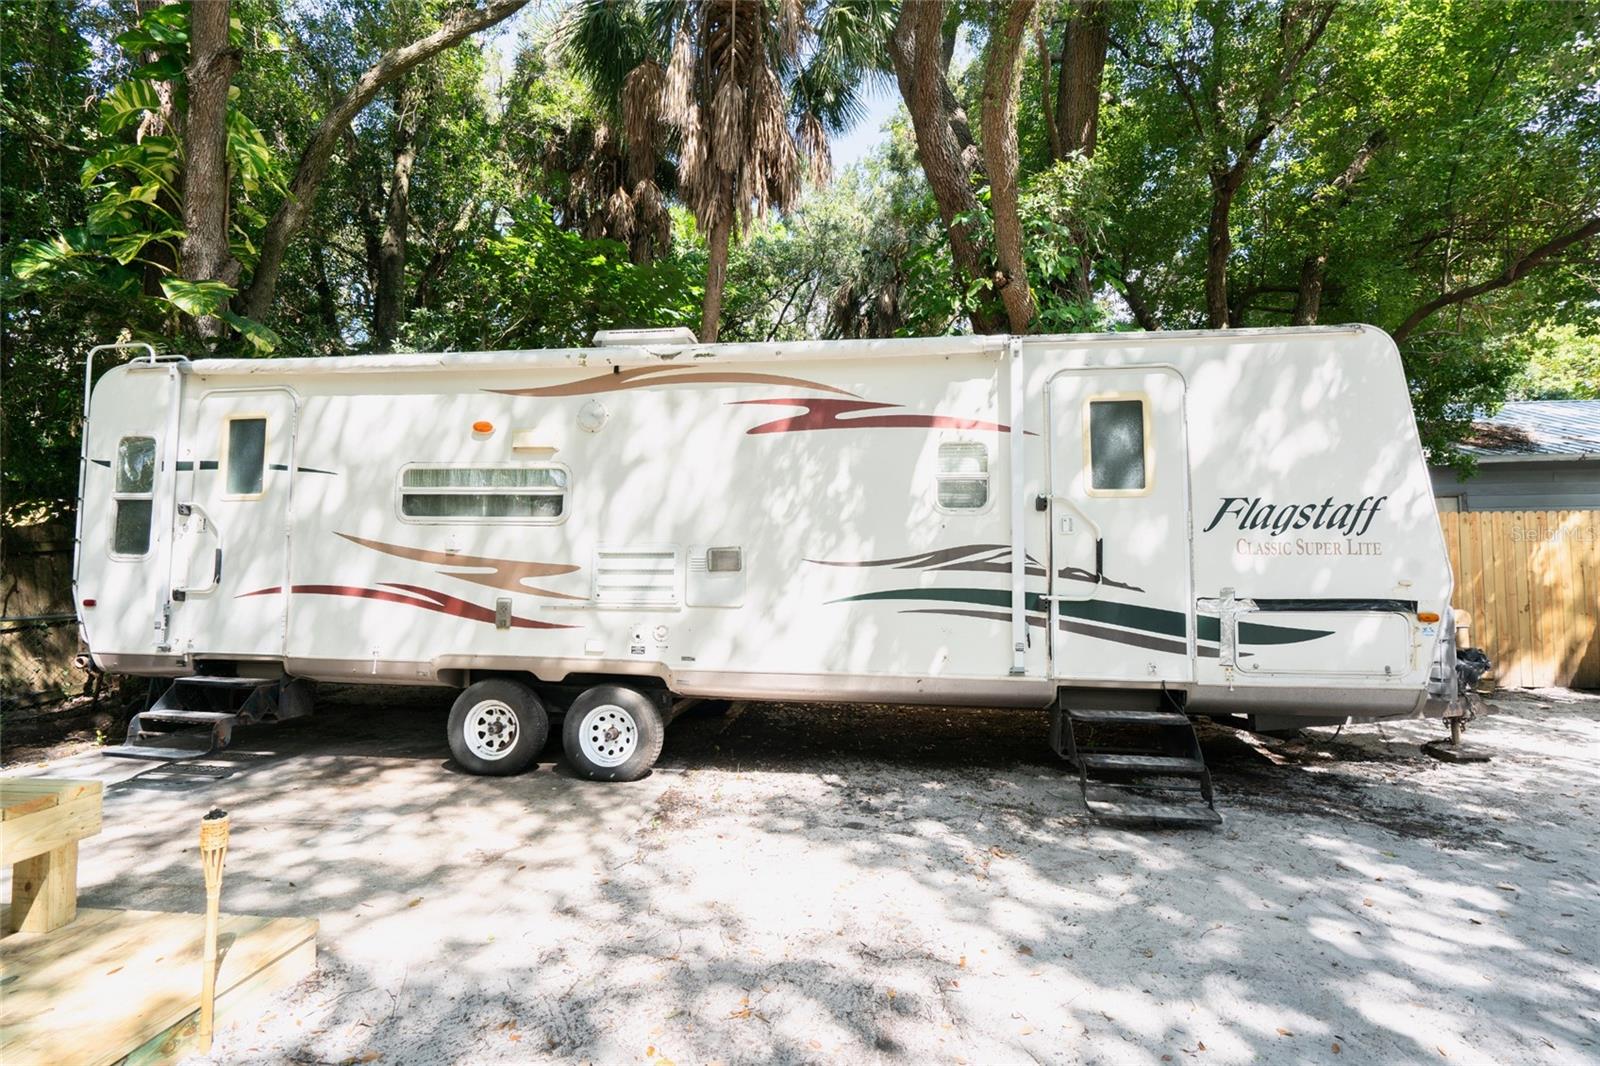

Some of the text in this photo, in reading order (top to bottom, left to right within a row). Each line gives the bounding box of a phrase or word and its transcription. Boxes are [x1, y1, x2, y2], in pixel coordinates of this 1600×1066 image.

[1203, 495, 1388, 537] Flagstaff
[1236, 538, 1383, 556] CLASSIC SUPER LITE
